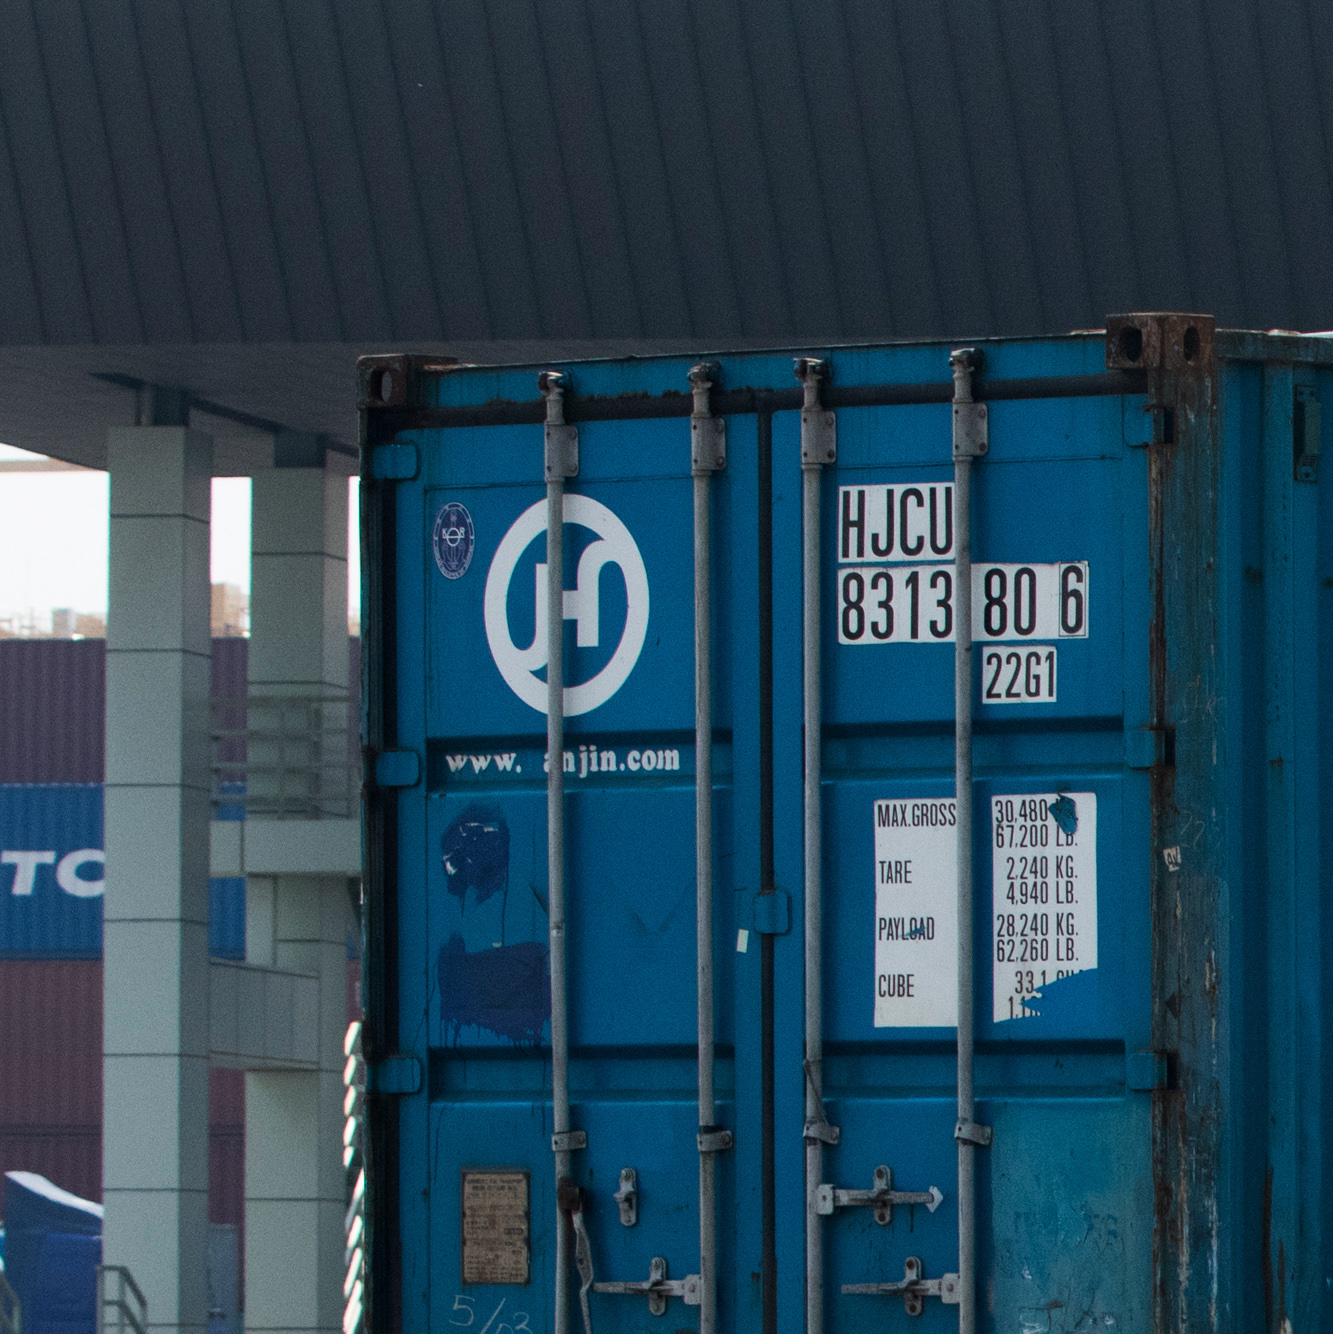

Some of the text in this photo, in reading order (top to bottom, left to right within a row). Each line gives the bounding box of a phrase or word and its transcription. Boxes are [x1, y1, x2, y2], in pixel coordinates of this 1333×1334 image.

[842, 487, 953, 558] HJCU
[1061, 565, 1084, 634] 6
[986, 651, 1055, 699] 22G1
[877, 803, 957, 828] MAX.GROSS
[995, 799, 1048, 824] 30,480
[995, 824, 1048, 848] 67,200
[879, 855, 1078, 884] TARE 2,240 KG.
[1006, 881, 1078, 905] 4,940 LB.
[878, 913, 1079, 941] PAYLOAD 28,240 KG.
[996, 938, 1079, 962] 62,260 LB.
[878, 974, 914, 998] CUBE
